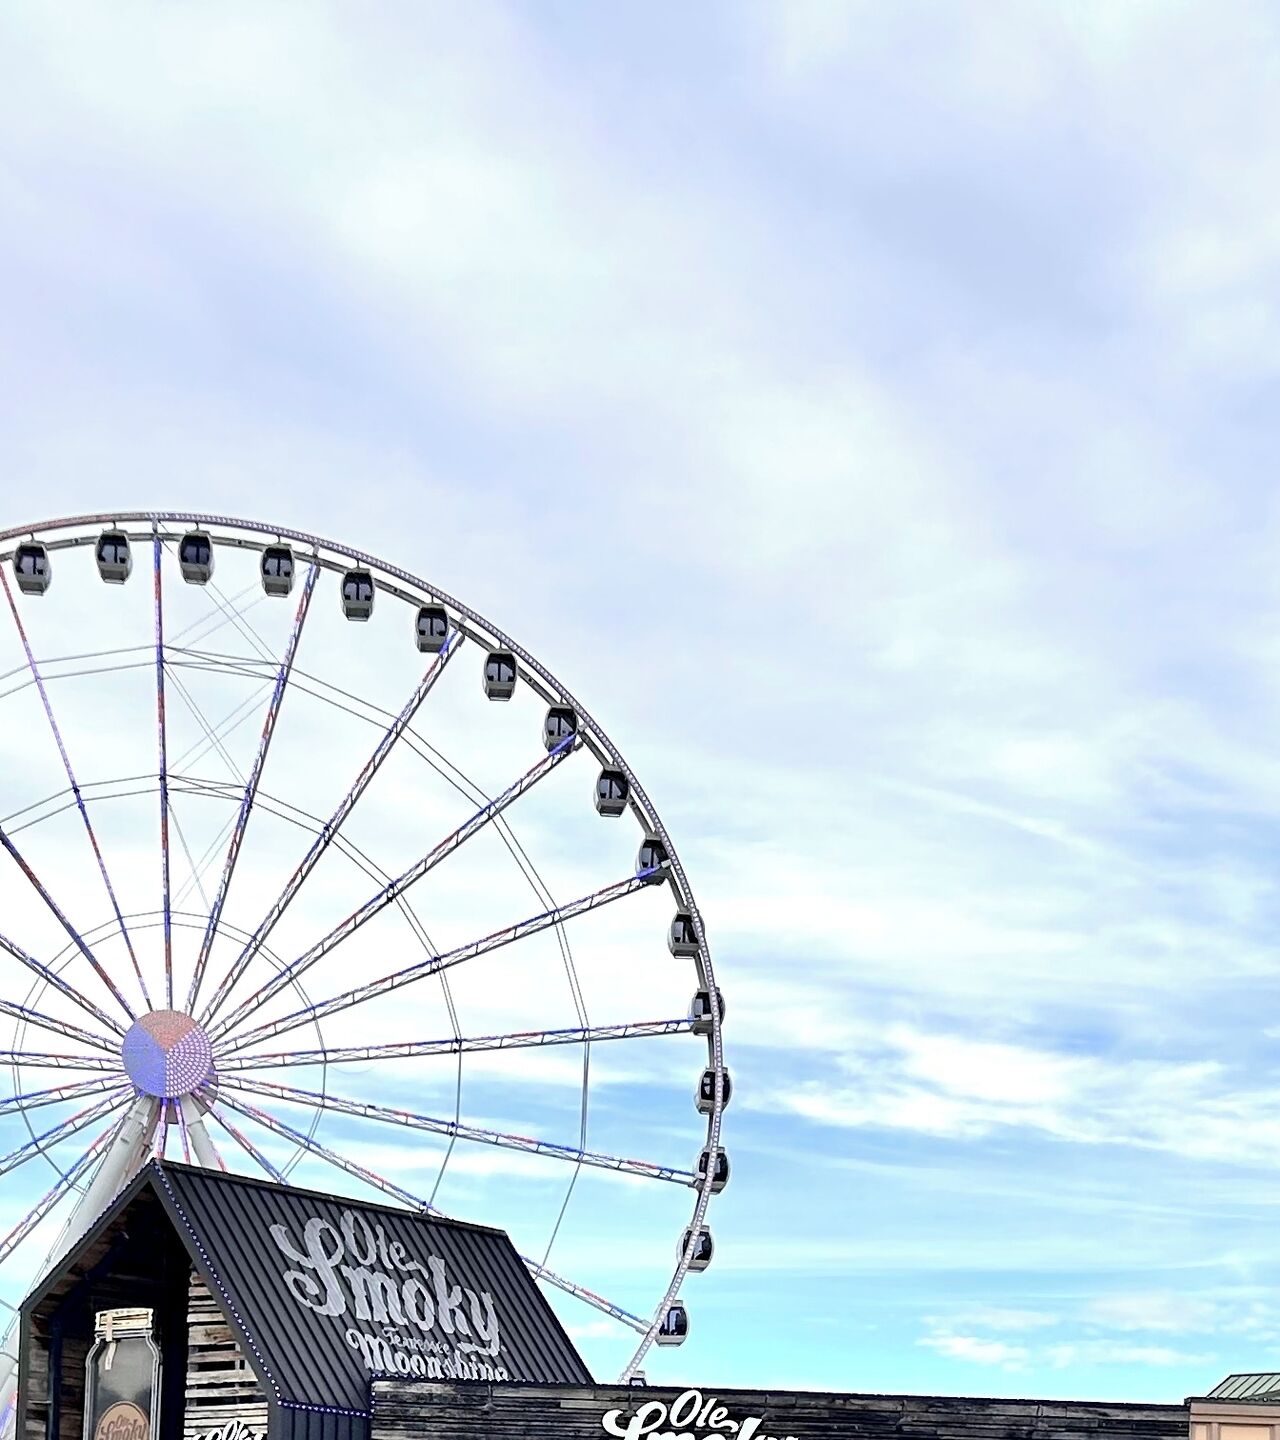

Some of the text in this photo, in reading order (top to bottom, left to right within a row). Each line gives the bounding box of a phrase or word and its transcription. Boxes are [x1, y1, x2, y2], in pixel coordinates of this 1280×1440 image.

[340, 1209, 429, 1279] Ole
[269, 1217, 501, 1357] Smoky
[345, 1328, 509, 1381] Moonshine
[670, 1389, 739, 1433] Ole
